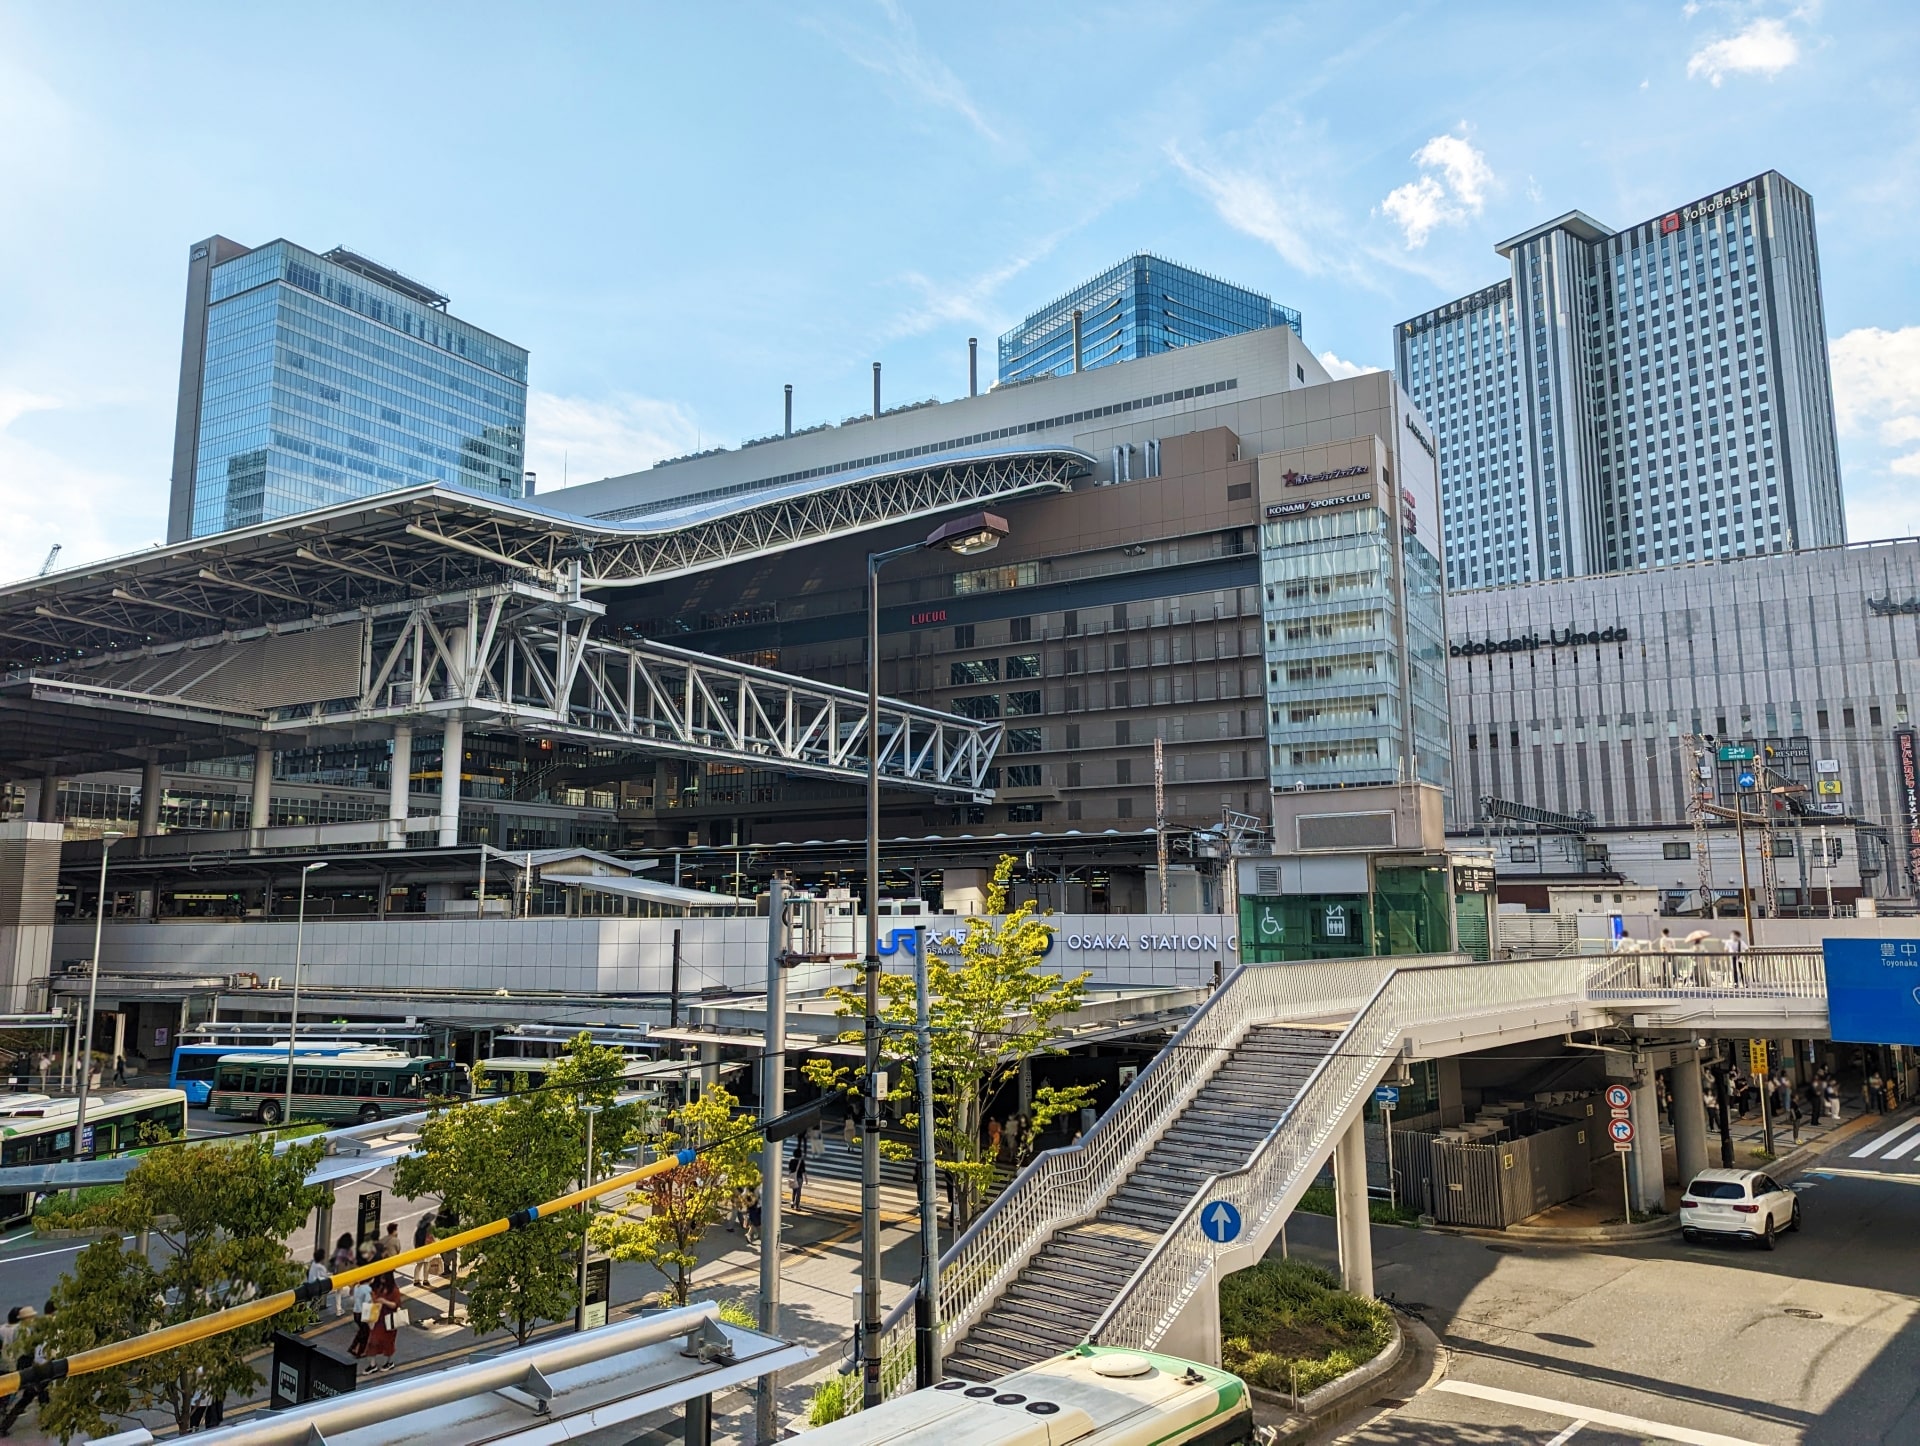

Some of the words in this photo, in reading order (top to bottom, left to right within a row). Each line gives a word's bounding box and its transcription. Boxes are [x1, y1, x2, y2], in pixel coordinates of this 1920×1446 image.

[1683, 188, 1753, 221] YODOBASHI
[1269, 503, 1305, 514] KONAMI
[1311, 496, 1345, 508] SPORTS
[1346, 492, 1371, 503] CLUB
[1449, 626, 1627, 657] odobashi-Umeda
[1775, 750, 1809, 758] RESPIRE
[877, 929, 916, 955] JR
[1068, 934, 1130, 950] OSAKA
[1140, 934, 1217, 950] STATION
[1880, 943, 1917, 957] 豊中
[1882, 958, 1918, 968] Toyonaka
